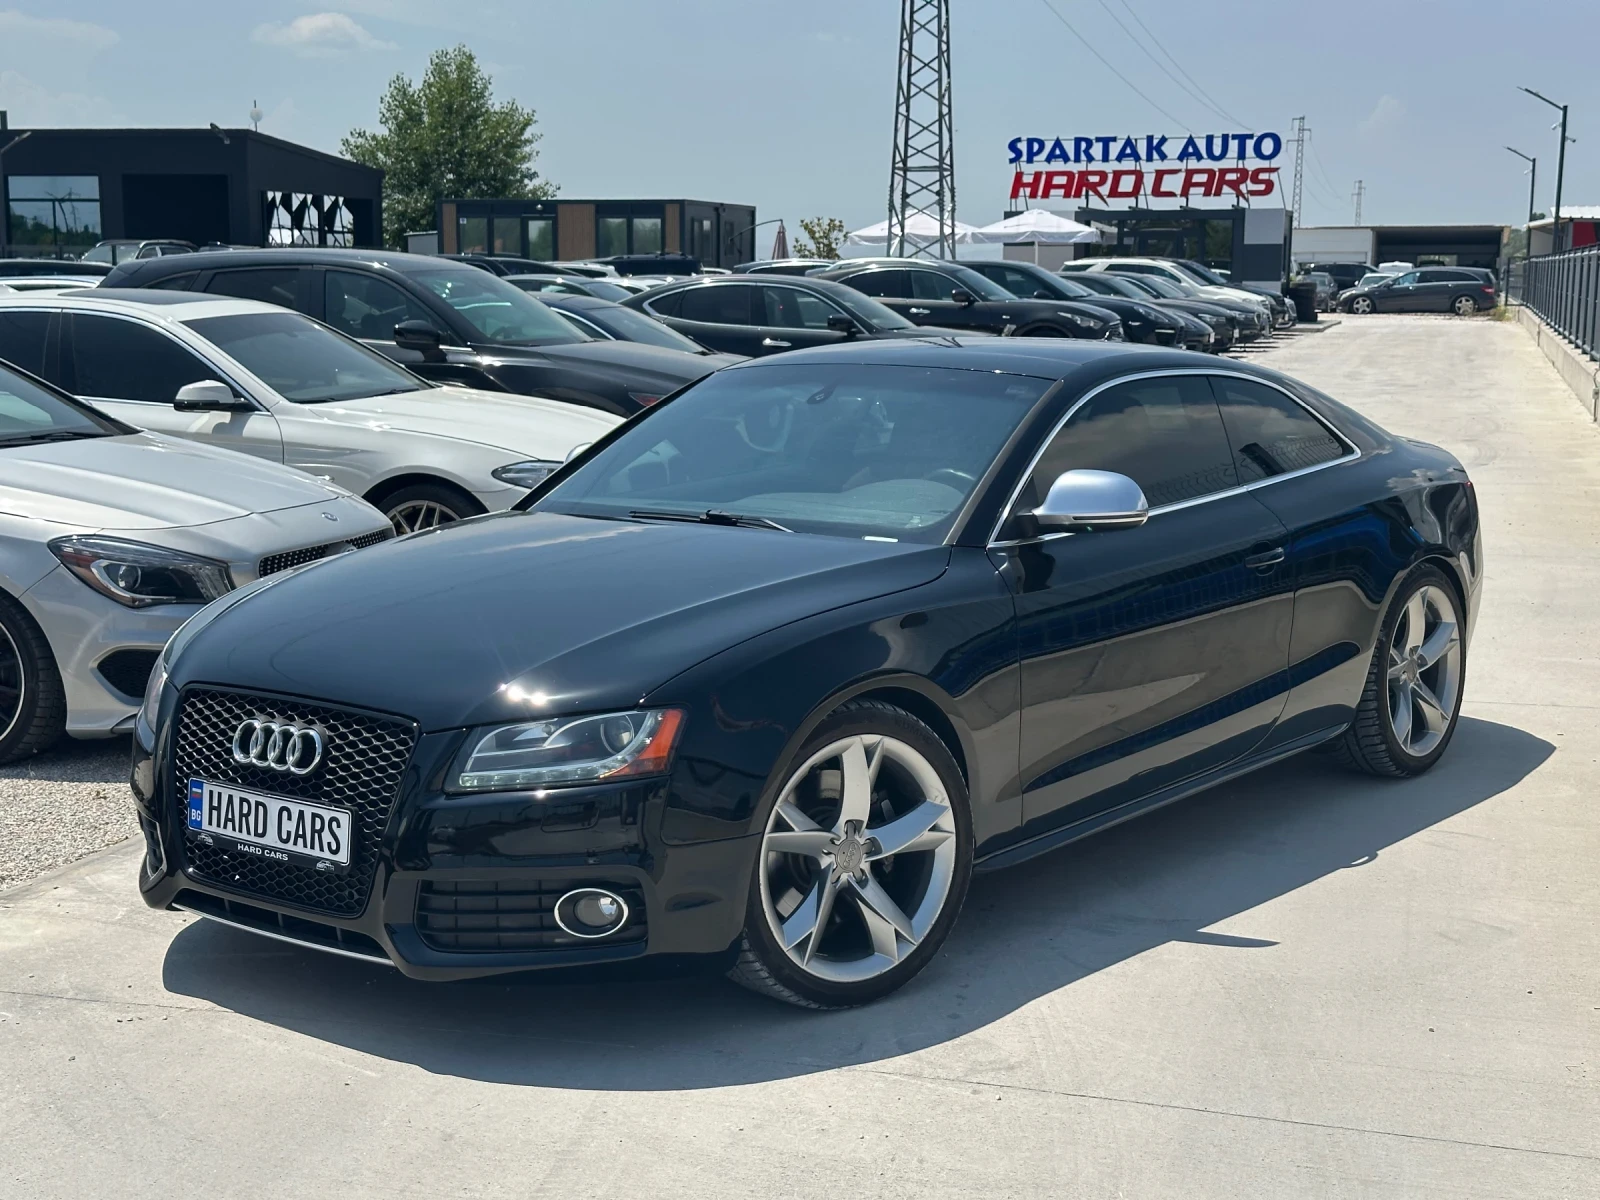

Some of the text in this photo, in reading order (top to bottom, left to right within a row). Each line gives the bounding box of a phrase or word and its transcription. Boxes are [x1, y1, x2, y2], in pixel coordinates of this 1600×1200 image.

[1008, 132, 1282, 164] SPARTAK AUTO
[1009, 167, 1281, 207] HARD CARS
[191, 790, 341, 856] BG HARD CARS
[237, 843, 288, 861] HARD CARS
